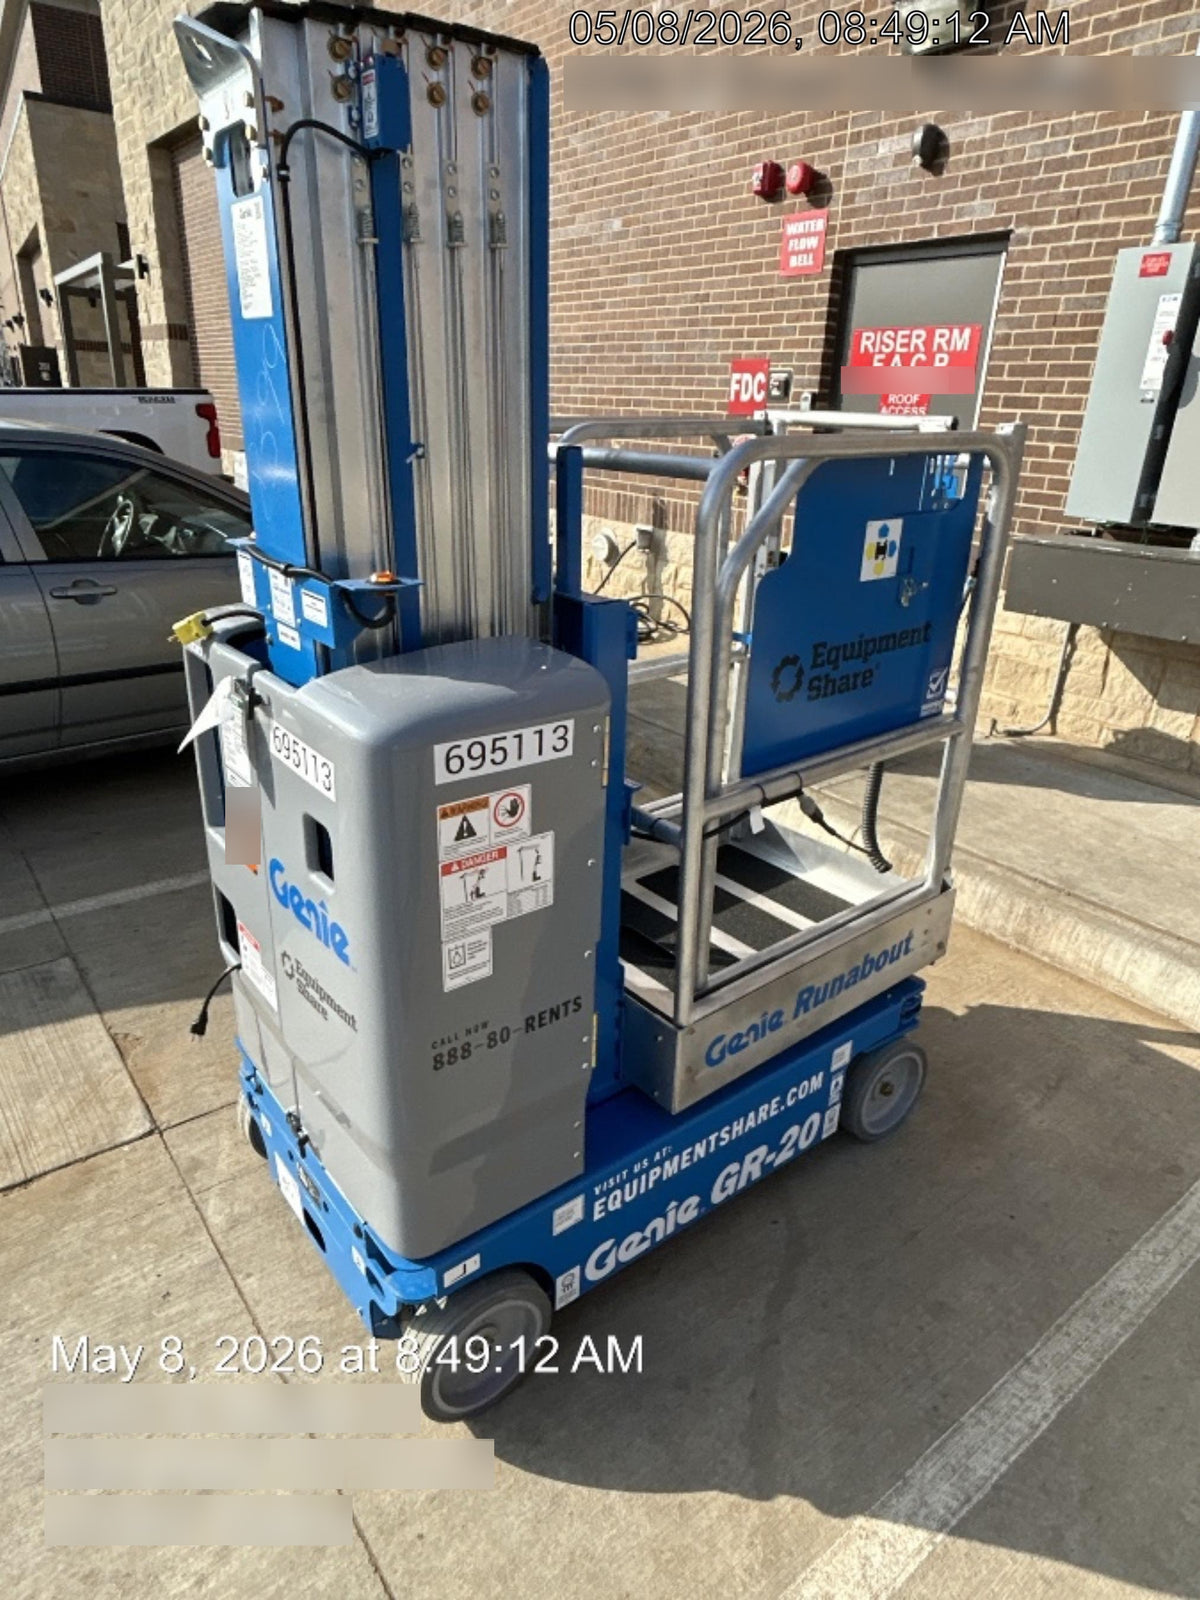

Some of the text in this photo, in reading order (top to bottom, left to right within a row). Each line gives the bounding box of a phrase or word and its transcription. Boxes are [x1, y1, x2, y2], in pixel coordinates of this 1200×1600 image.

[786, 218, 824, 235] WATER
[788, 236, 819, 252] FLOW
[788, 253, 814, 267] BELL
[860, 327, 971, 354] RISER RM
[730, 371, 767, 403] FDC
[888, 394, 921, 404] ROOF
[810, 620, 932, 670] Equipment
[807, 667, 874, 701] Share
[273, 725, 332, 792] 695113
[445, 724, 569, 774] 695113
[269, 858, 351, 967] Genie
[295, 957, 358, 1033] Equipment
[296, 978, 329, 1021] Share
[705, 1009, 785, 1067] Genie
[793, 929, 914, 1020] Runabout
[431, 1020, 490, 1050] CALL NOW
[432, 996, 583, 1071] 888-80-RENTS
[593, 1071, 824, 1222] EQUIPMENTSHARE.COM
[584, 1195, 701, 1281] Genie
[711, 1112, 821, 1204] GR-20
[594, 1170, 629, 1195] VISIT
[633, 1158, 650, 1174] US
